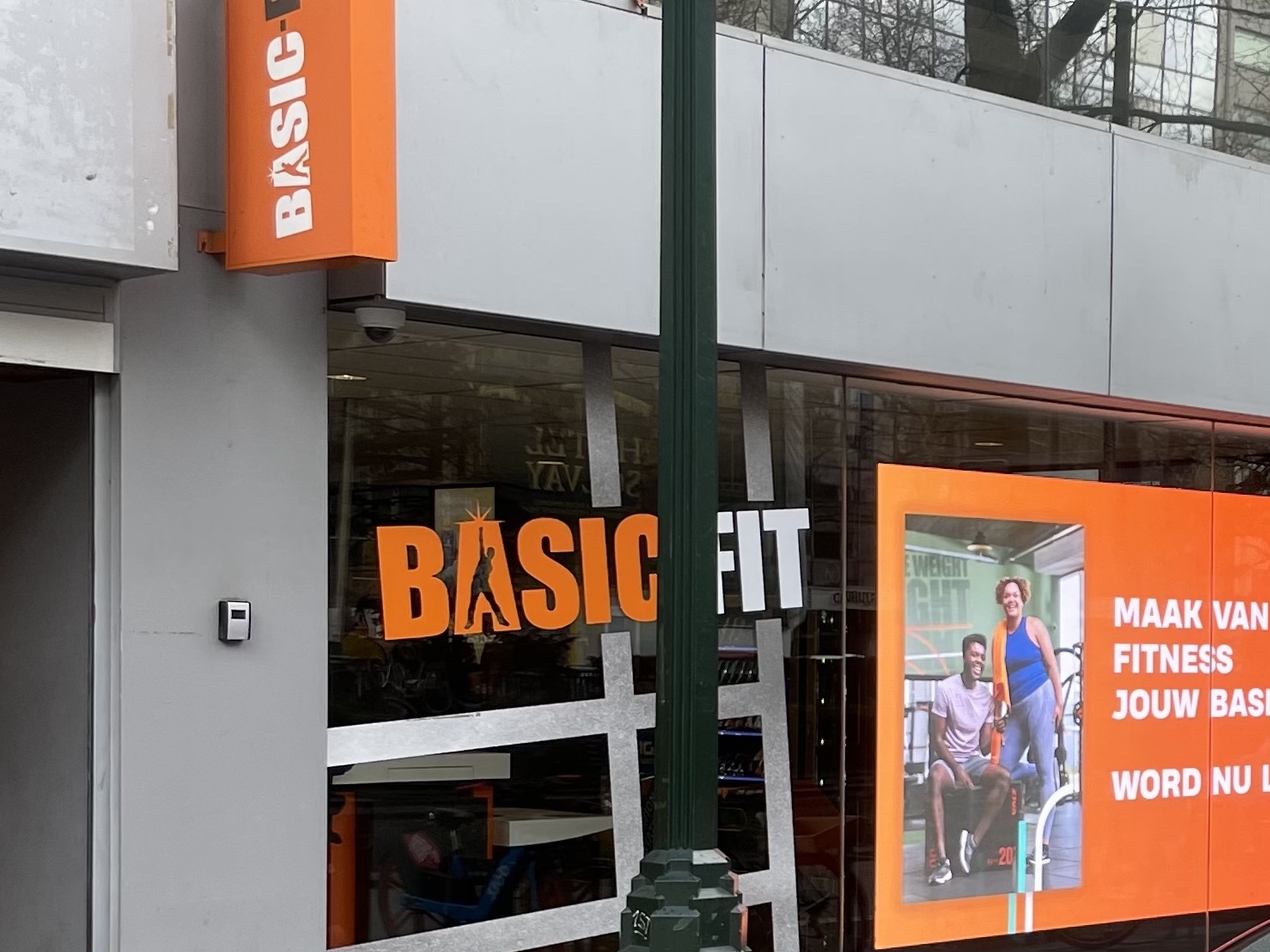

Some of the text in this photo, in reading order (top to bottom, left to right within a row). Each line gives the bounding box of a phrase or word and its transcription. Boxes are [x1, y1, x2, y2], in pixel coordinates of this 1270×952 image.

[376, 508, 658, 641] BASIC
[1114, 597, 1268, 630] MAAK VAN
[1113, 643, 1234, 674] FITNESS
[1112, 689, 1199, 720] JOUW
[1111, 767, 1202, 800] WORD
[1212, 765, 1251, 795] NU
